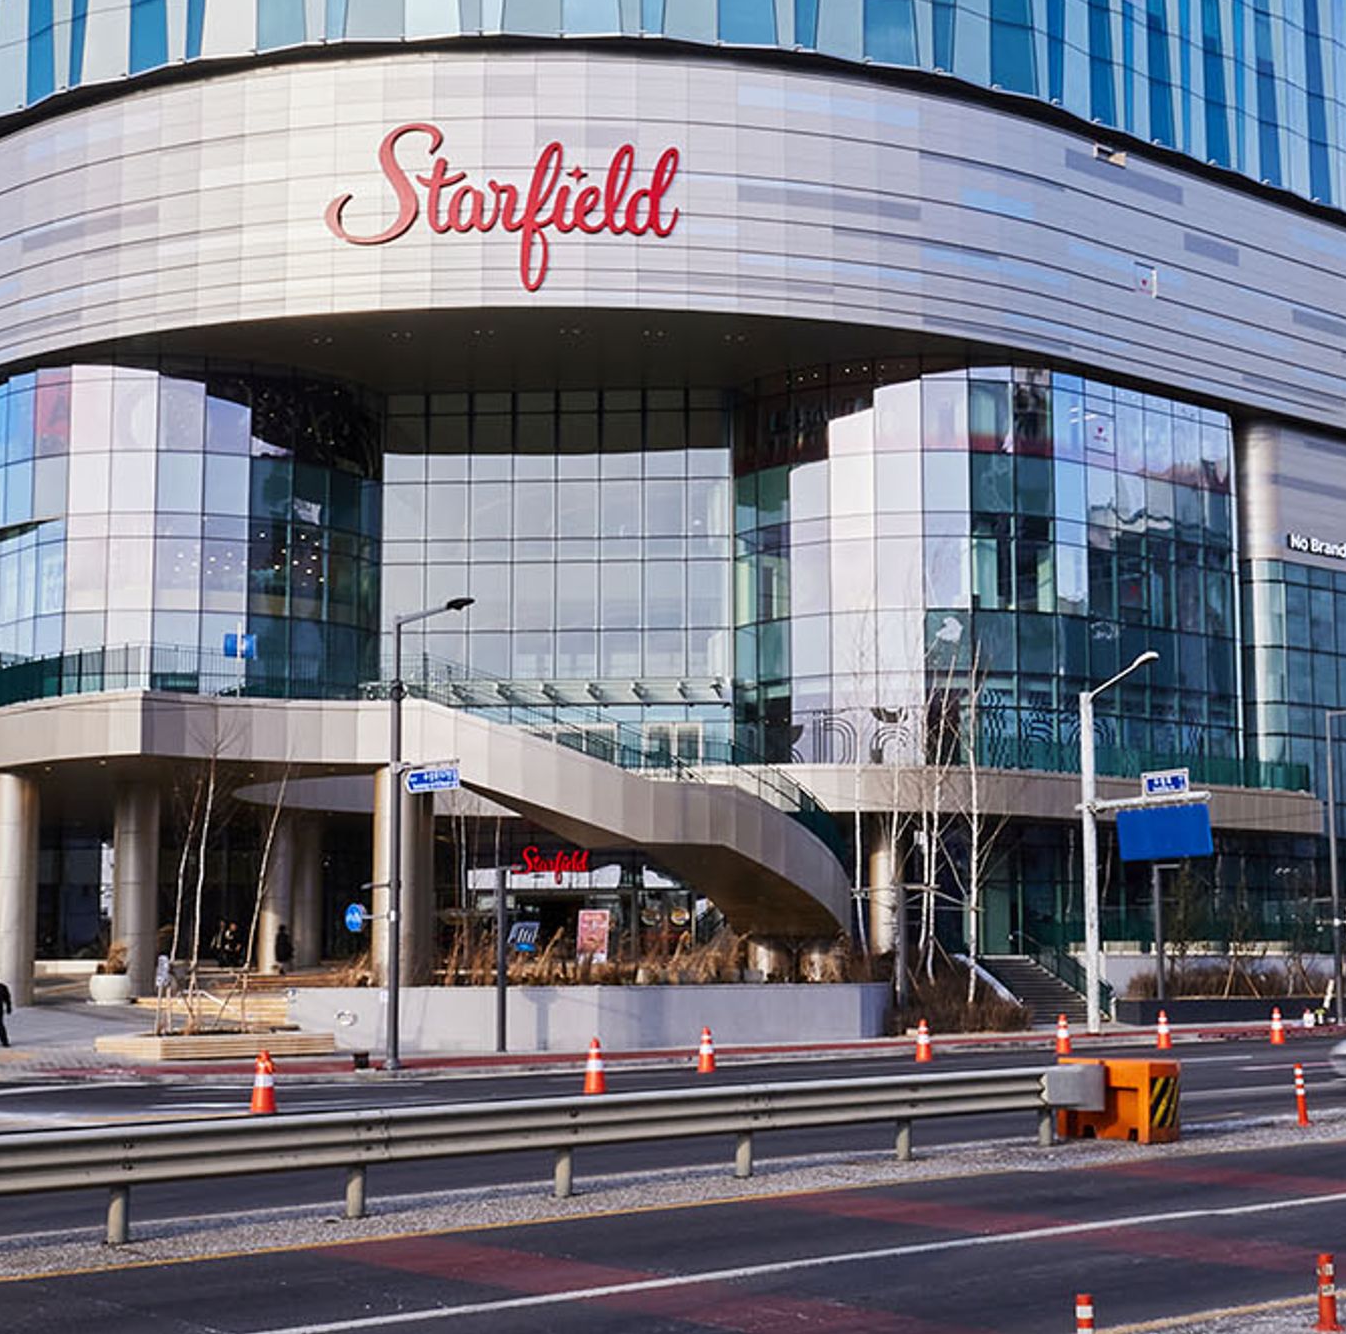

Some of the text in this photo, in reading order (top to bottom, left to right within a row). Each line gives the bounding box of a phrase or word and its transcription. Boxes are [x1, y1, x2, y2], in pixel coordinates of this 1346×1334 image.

[325, 122, 680, 292] Starfield
[1290, 533, 1309, 552] No
[510, 845, 590, 886] Starfield
